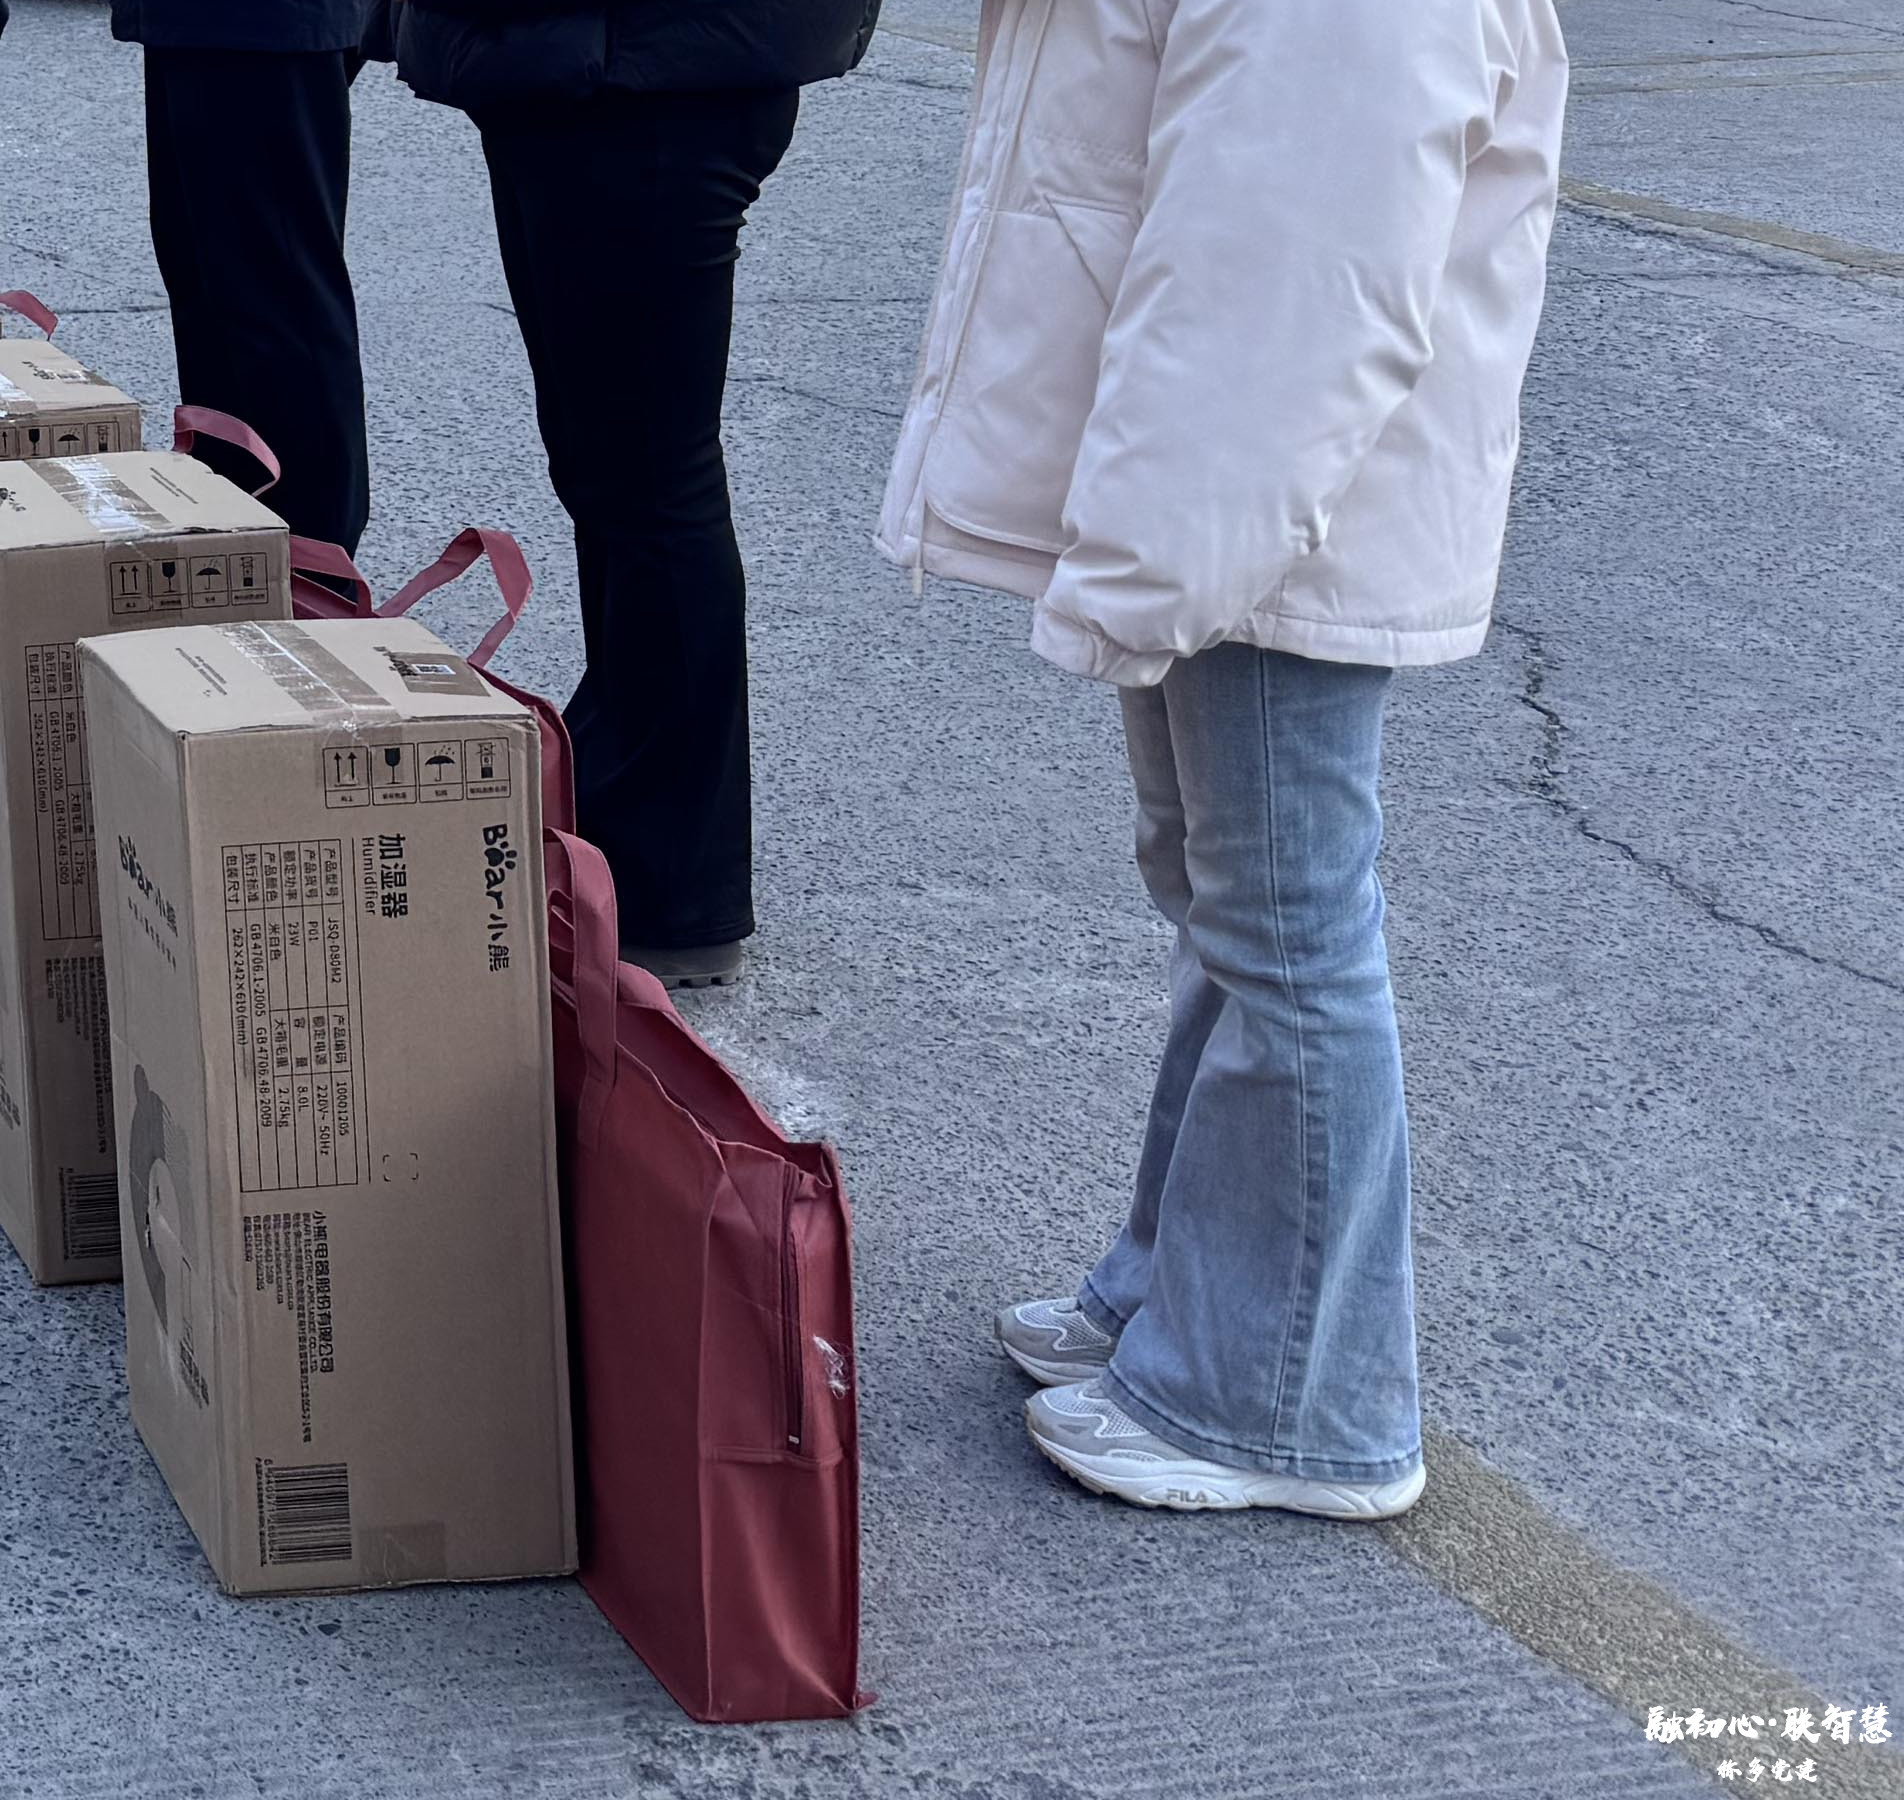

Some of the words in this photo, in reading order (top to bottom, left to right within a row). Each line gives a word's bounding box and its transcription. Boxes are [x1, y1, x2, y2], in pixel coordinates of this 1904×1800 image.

[225, 855, 240, 905] 包装尺寸
[244, 853, 260, 903] 执行标准
[263, 851, 279, 903] 产品颜色
[283, 849, 298, 901] 额定功率
[303, 848, 319, 899] 产品货号
[323, 847, 339, 898] 产品型号
[361, 836, 379, 916] Humidifier
[378, 833, 409, 919] 加湿器
[482, 823, 518, 910] Bear
[268, 922, 280, 961] 米白色
[288, 921, 300, 947] 23W
[307, 921, 319, 942] P01
[486, 913, 510, 973] 小熊
[312, 1015, 328, 1066] 额定电源
[332, 1013, 348, 1064] 产品编码
[277, 1087, 291, 1128] 2.75kg
[296, 1086, 310, 1112] 8.0L
[335, 1081, 350, 1137] 10001205
[318, 1125, 331, 1156] 50Hz
[312, 1210, 334, 1374] 小熊电器股份有限公司
[1166, 1487, 1209, 1504] FILA
